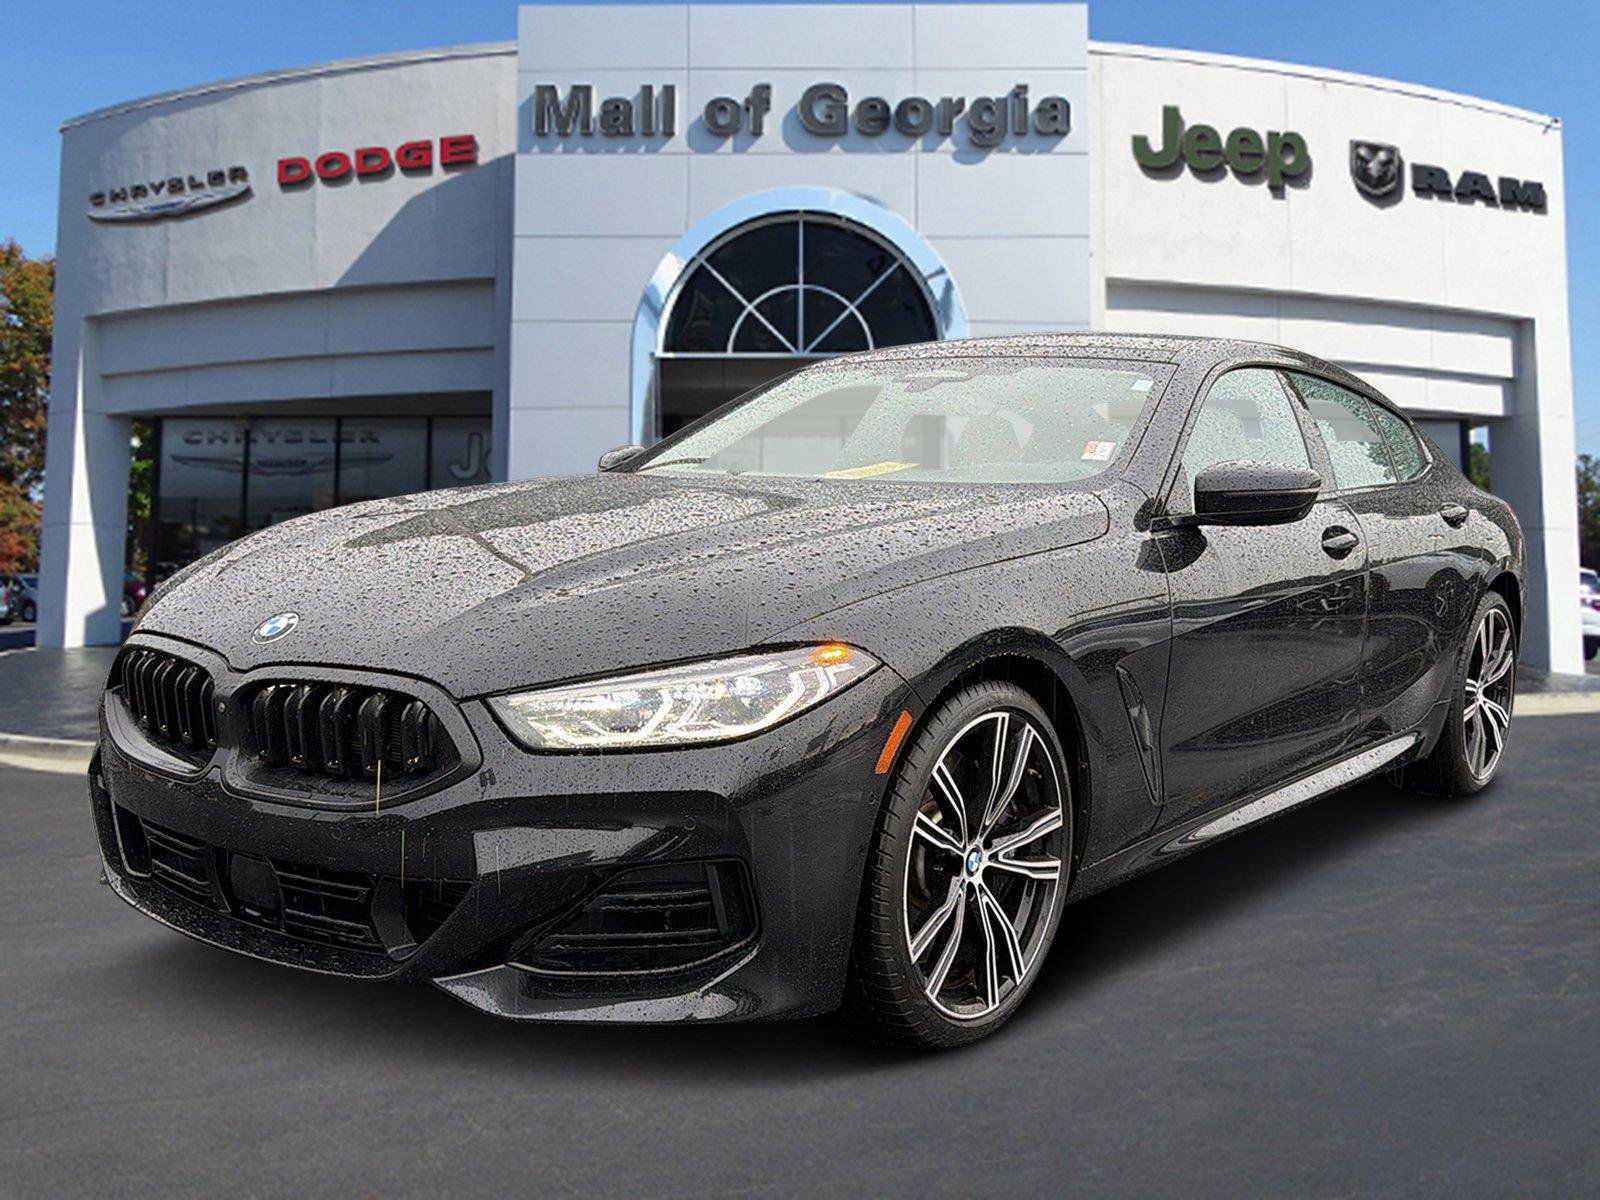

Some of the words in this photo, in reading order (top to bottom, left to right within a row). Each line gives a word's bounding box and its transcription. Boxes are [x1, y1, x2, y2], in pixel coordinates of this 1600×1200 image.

[533, 84, 677, 137] Mall
[703, 84, 772, 137] of
[799, 83, 1072, 148] Georgia
[276, 134, 477, 184] DODGE
[1131, 104, 1310, 189] Jeep
[89, 166, 250, 207] CHRYSLER
[1411, 163, 1547, 208] RAM
